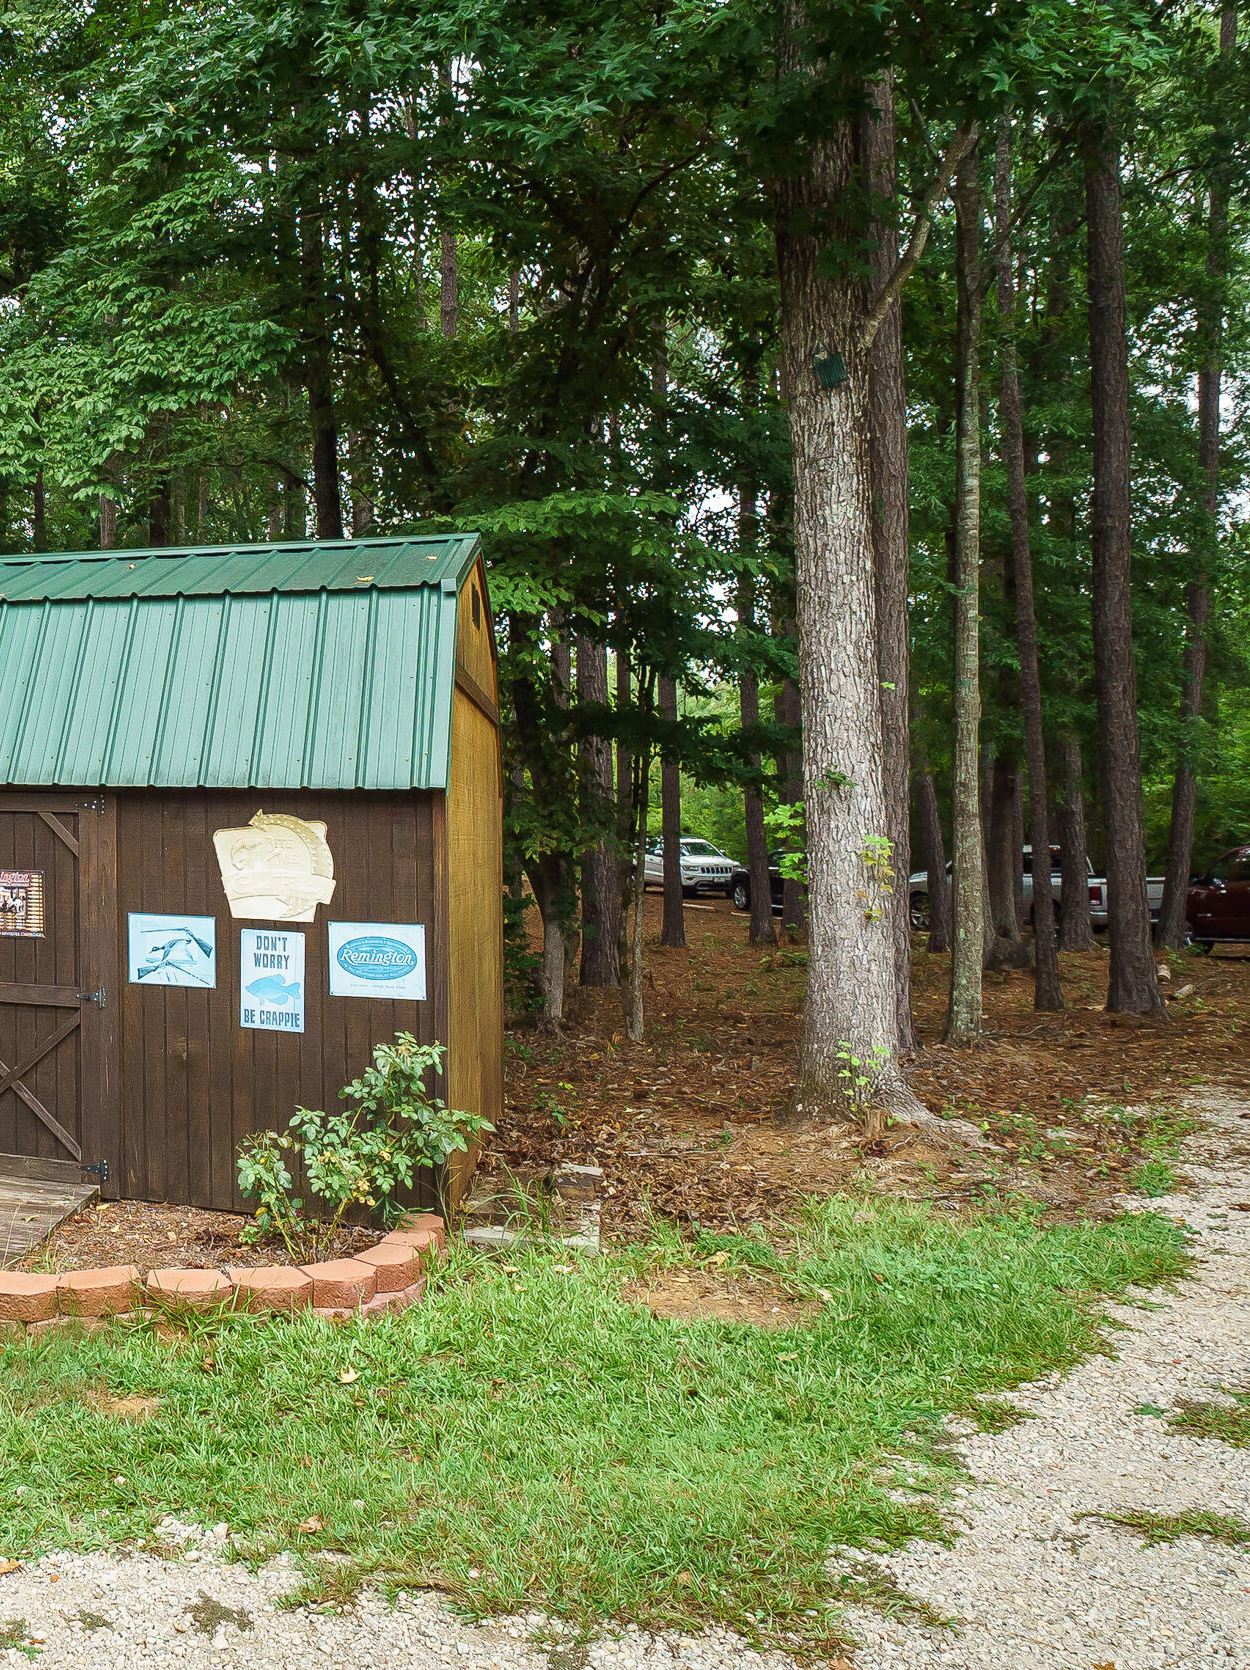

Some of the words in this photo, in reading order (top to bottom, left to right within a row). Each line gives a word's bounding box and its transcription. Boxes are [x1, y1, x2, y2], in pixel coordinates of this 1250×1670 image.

[256, 935, 288, 952] DON'T
[254, 952, 290, 970] WORRY
[340, 948, 414, 967] Remington
[244, 1008, 255, 1024] BE
[259, 1009, 300, 1028] CRAPPIE
